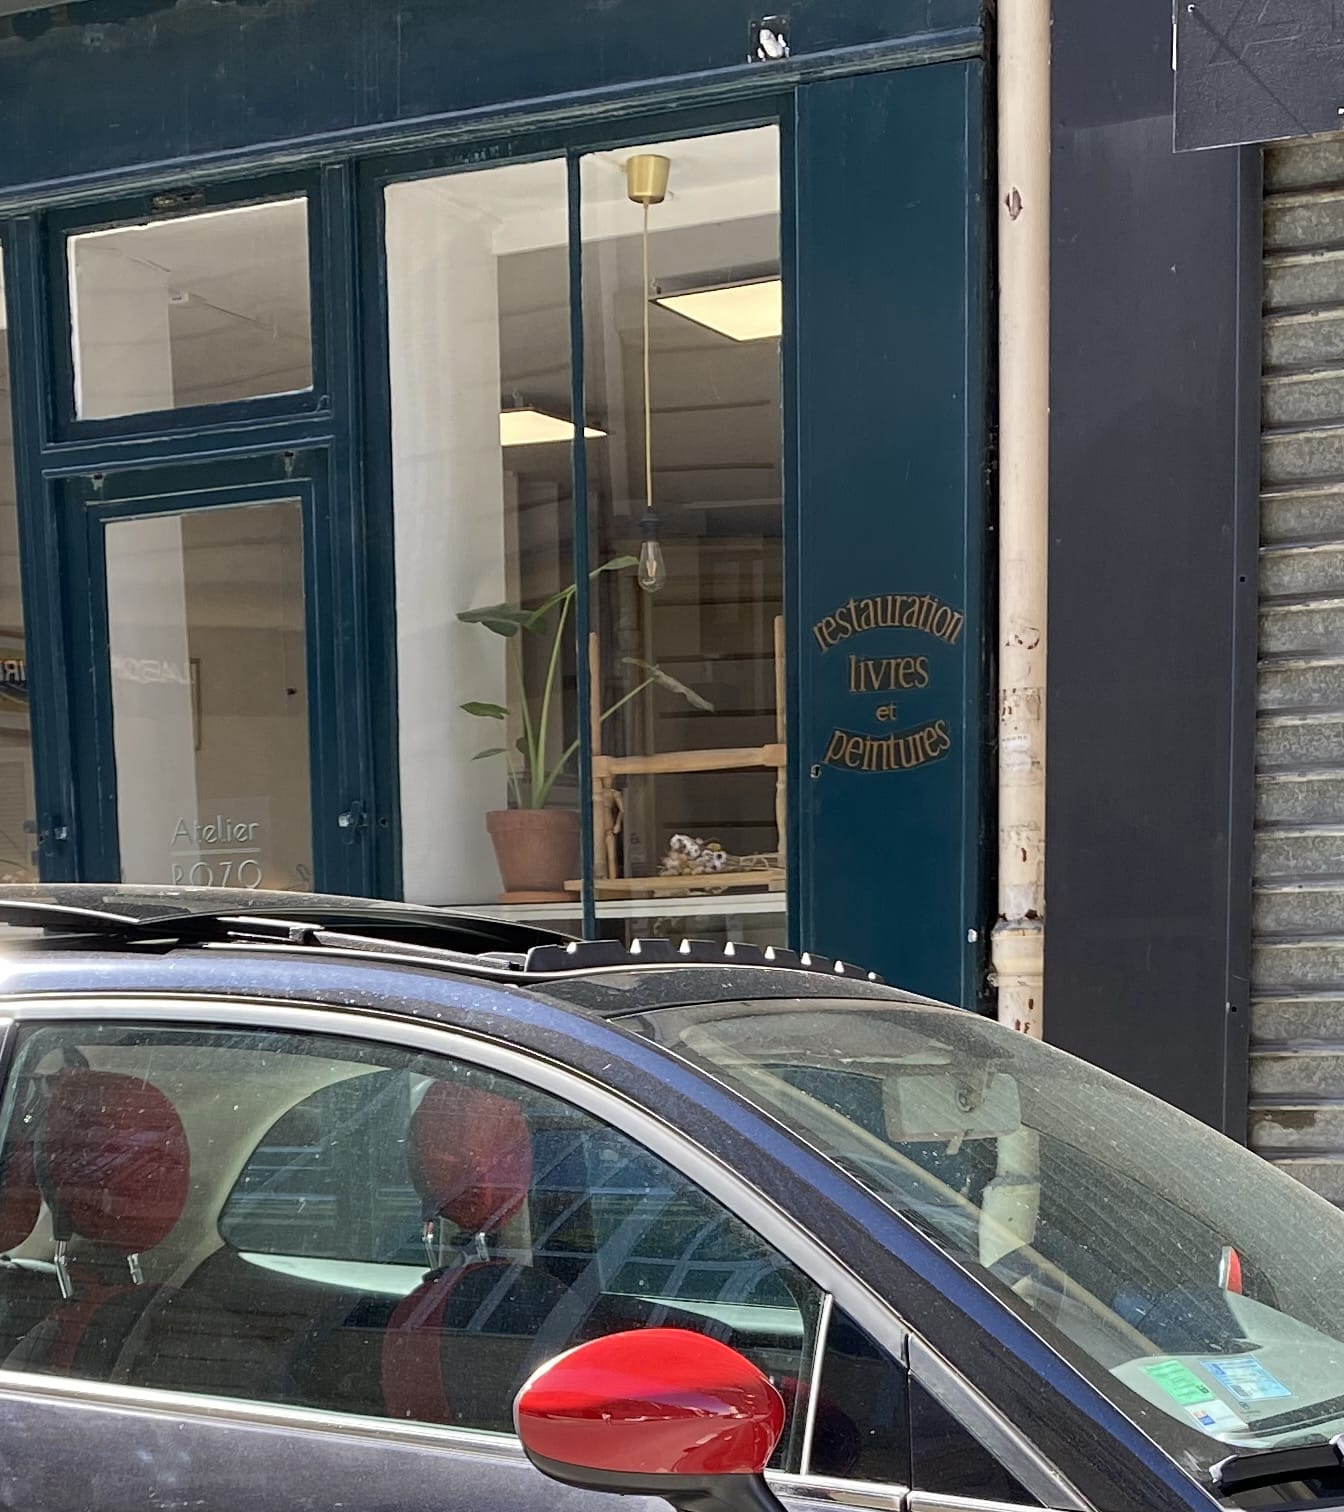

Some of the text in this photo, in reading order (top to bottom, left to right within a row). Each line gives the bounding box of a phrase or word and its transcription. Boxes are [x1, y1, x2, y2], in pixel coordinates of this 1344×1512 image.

[812, 592, 965, 652] restauration
[849, 655, 929, 692] livres
[875, 703, 897, 721] et
[823, 719, 952, 771] peintures
[171, 815, 260, 846] Atelier
